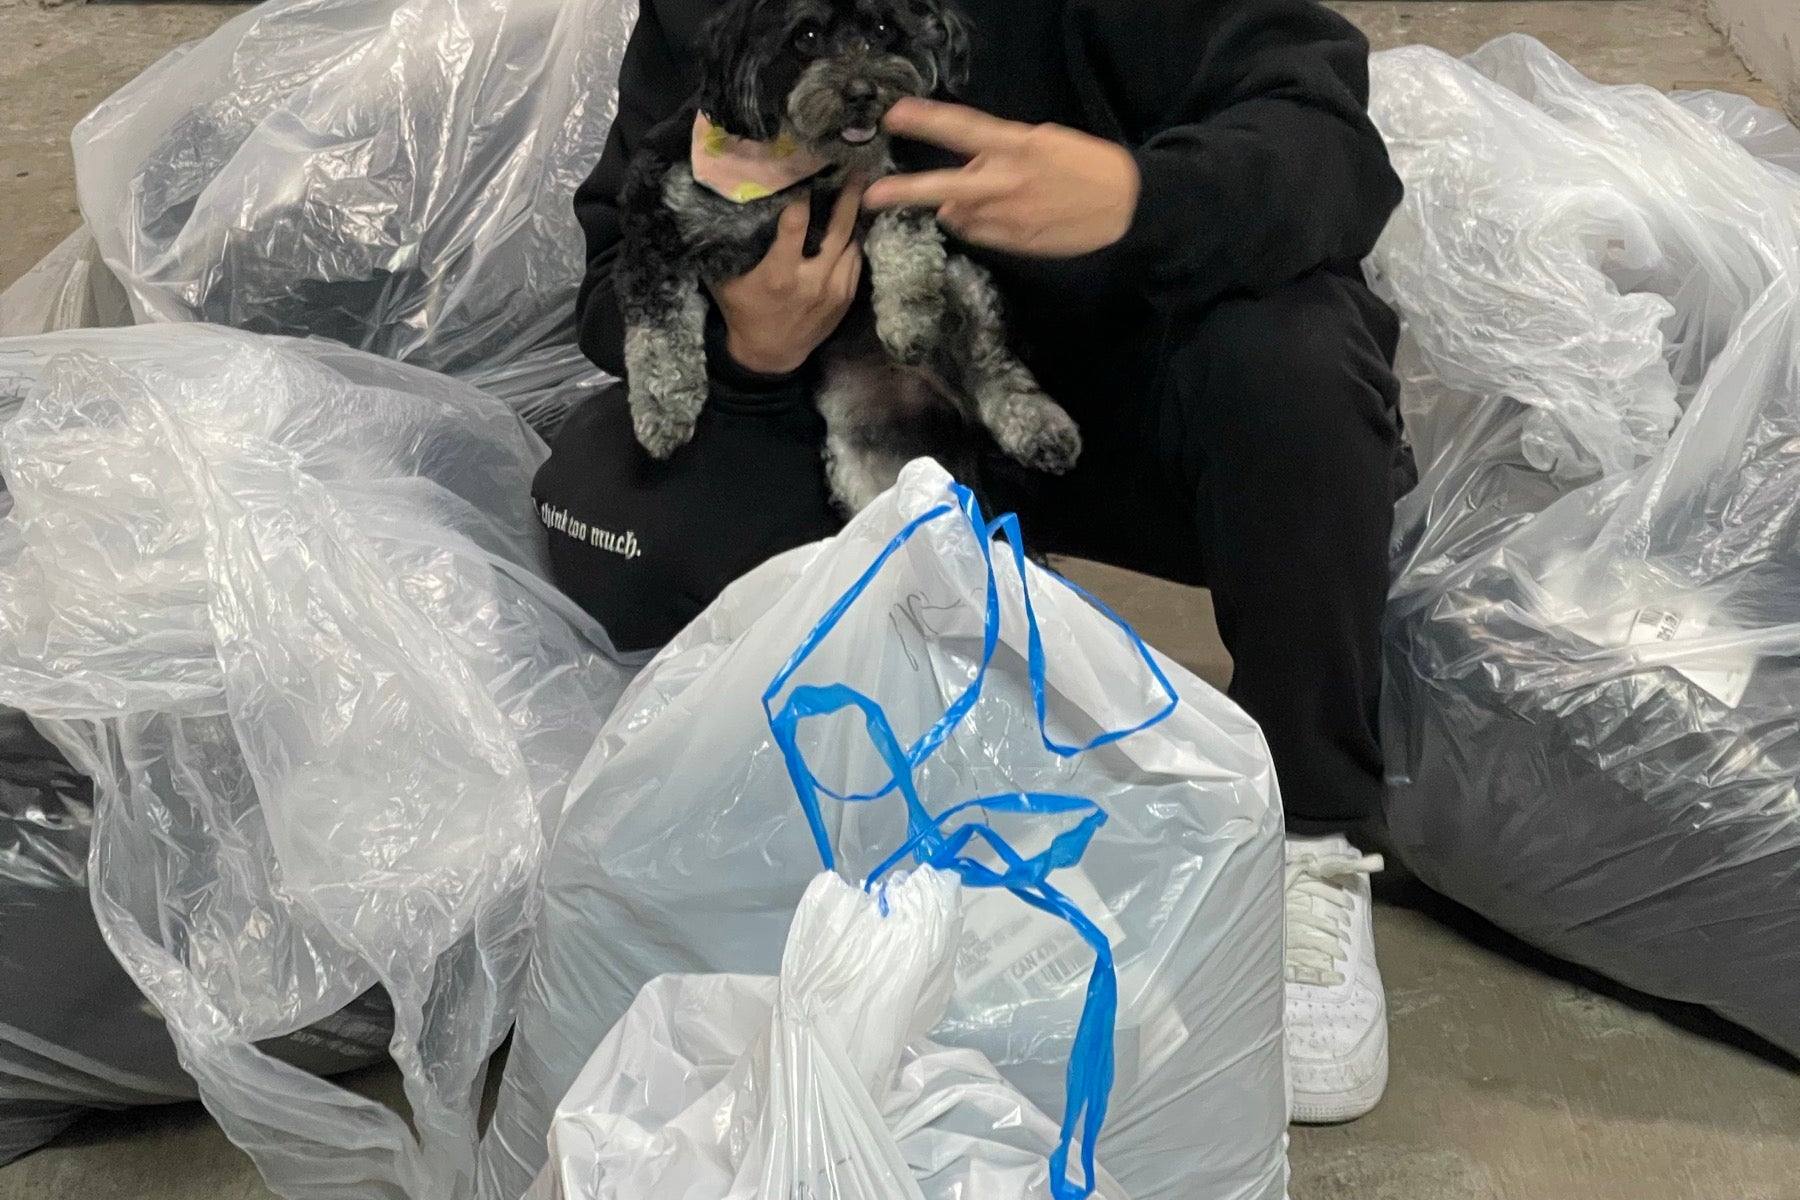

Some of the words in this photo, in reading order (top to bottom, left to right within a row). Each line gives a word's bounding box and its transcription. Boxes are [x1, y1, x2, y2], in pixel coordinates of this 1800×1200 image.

[541, 502, 568, 532] think
[568, 515, 587, 541] too
[590, 526, 641, 560] much.
